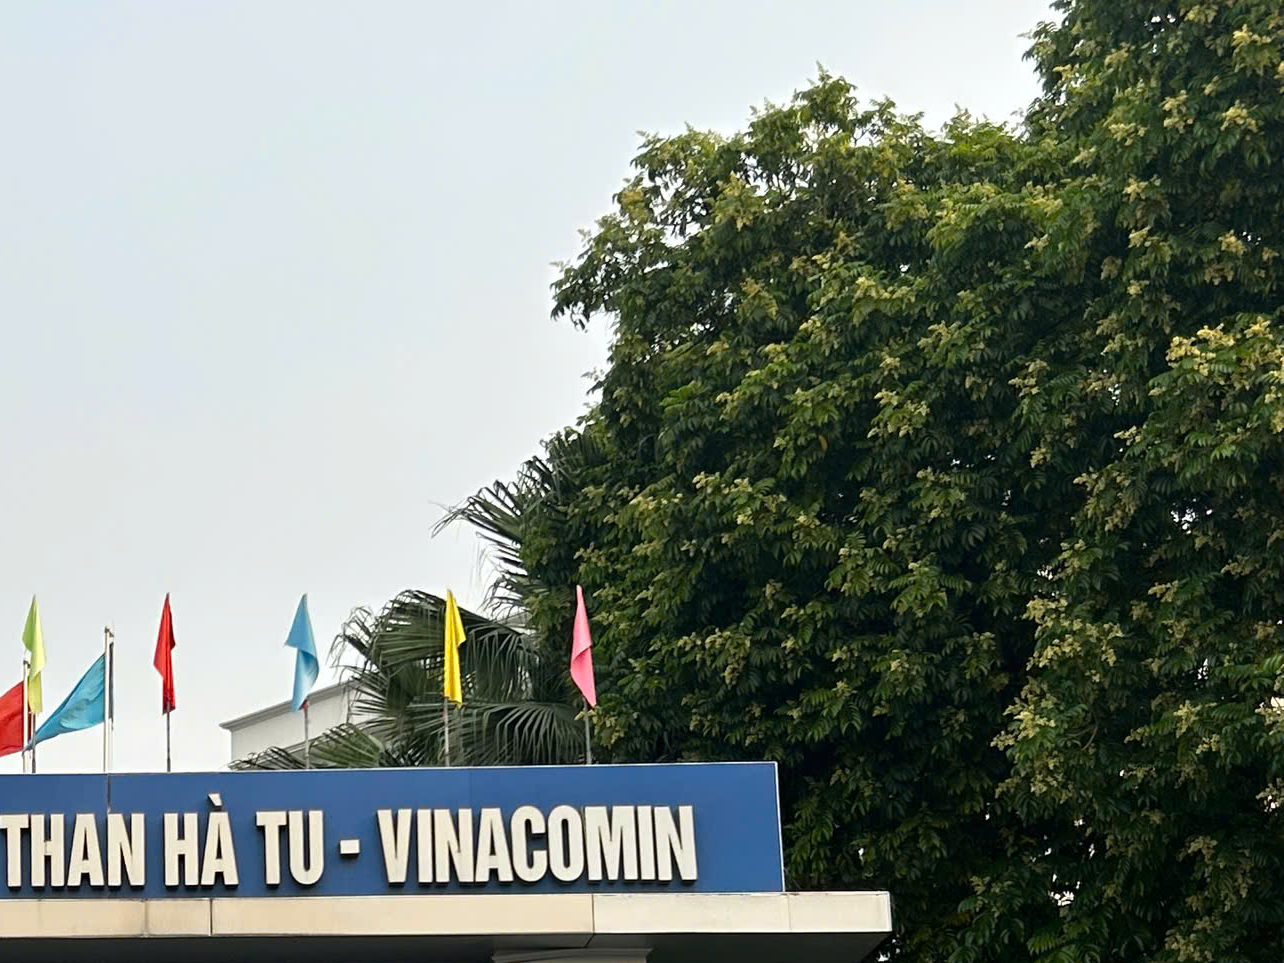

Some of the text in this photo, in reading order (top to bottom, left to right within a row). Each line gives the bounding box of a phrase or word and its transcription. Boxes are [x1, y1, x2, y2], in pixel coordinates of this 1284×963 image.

[162, 793, 240, 886] HÀ
[256, 810, 325, 885] TU
[377, 804, 698, 884] VINACOMIN
